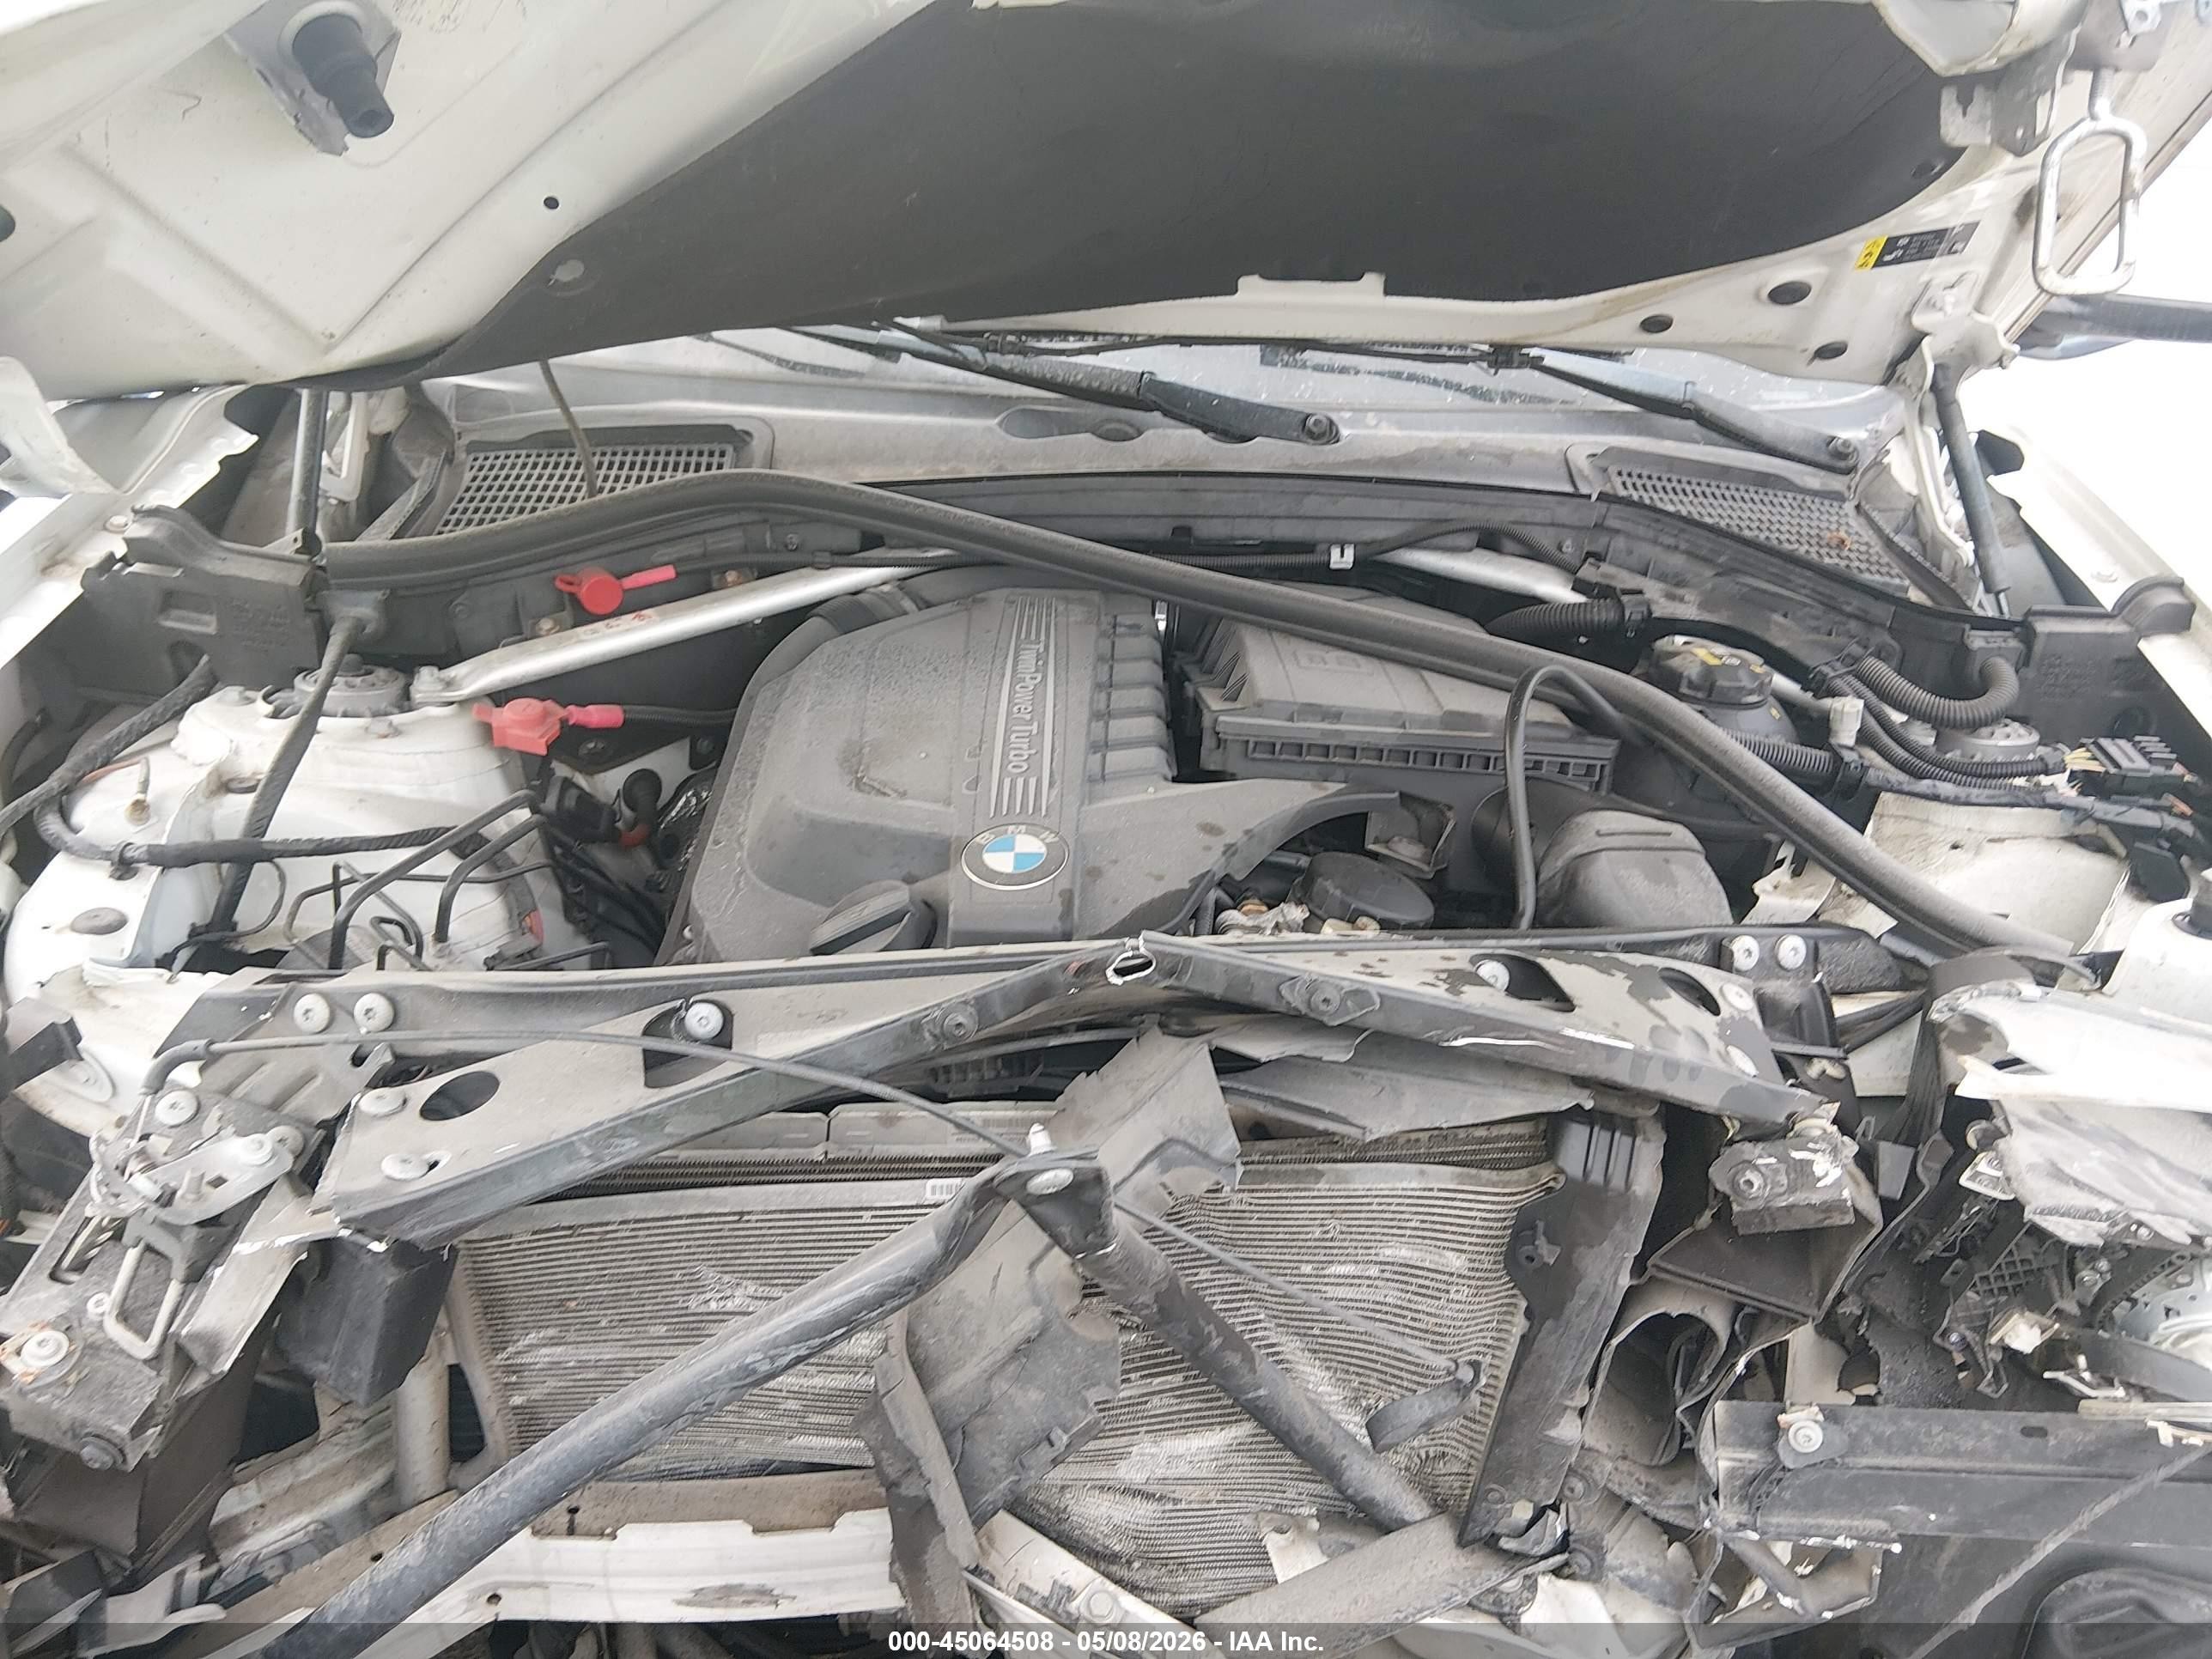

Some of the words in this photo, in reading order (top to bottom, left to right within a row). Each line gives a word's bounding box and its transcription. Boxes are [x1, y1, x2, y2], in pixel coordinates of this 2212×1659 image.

[1012, 639, 1045, 720] TwinPower
[1006, 721, 1039, 774] Turbo
[975, 824, 1060, 846] BMW
